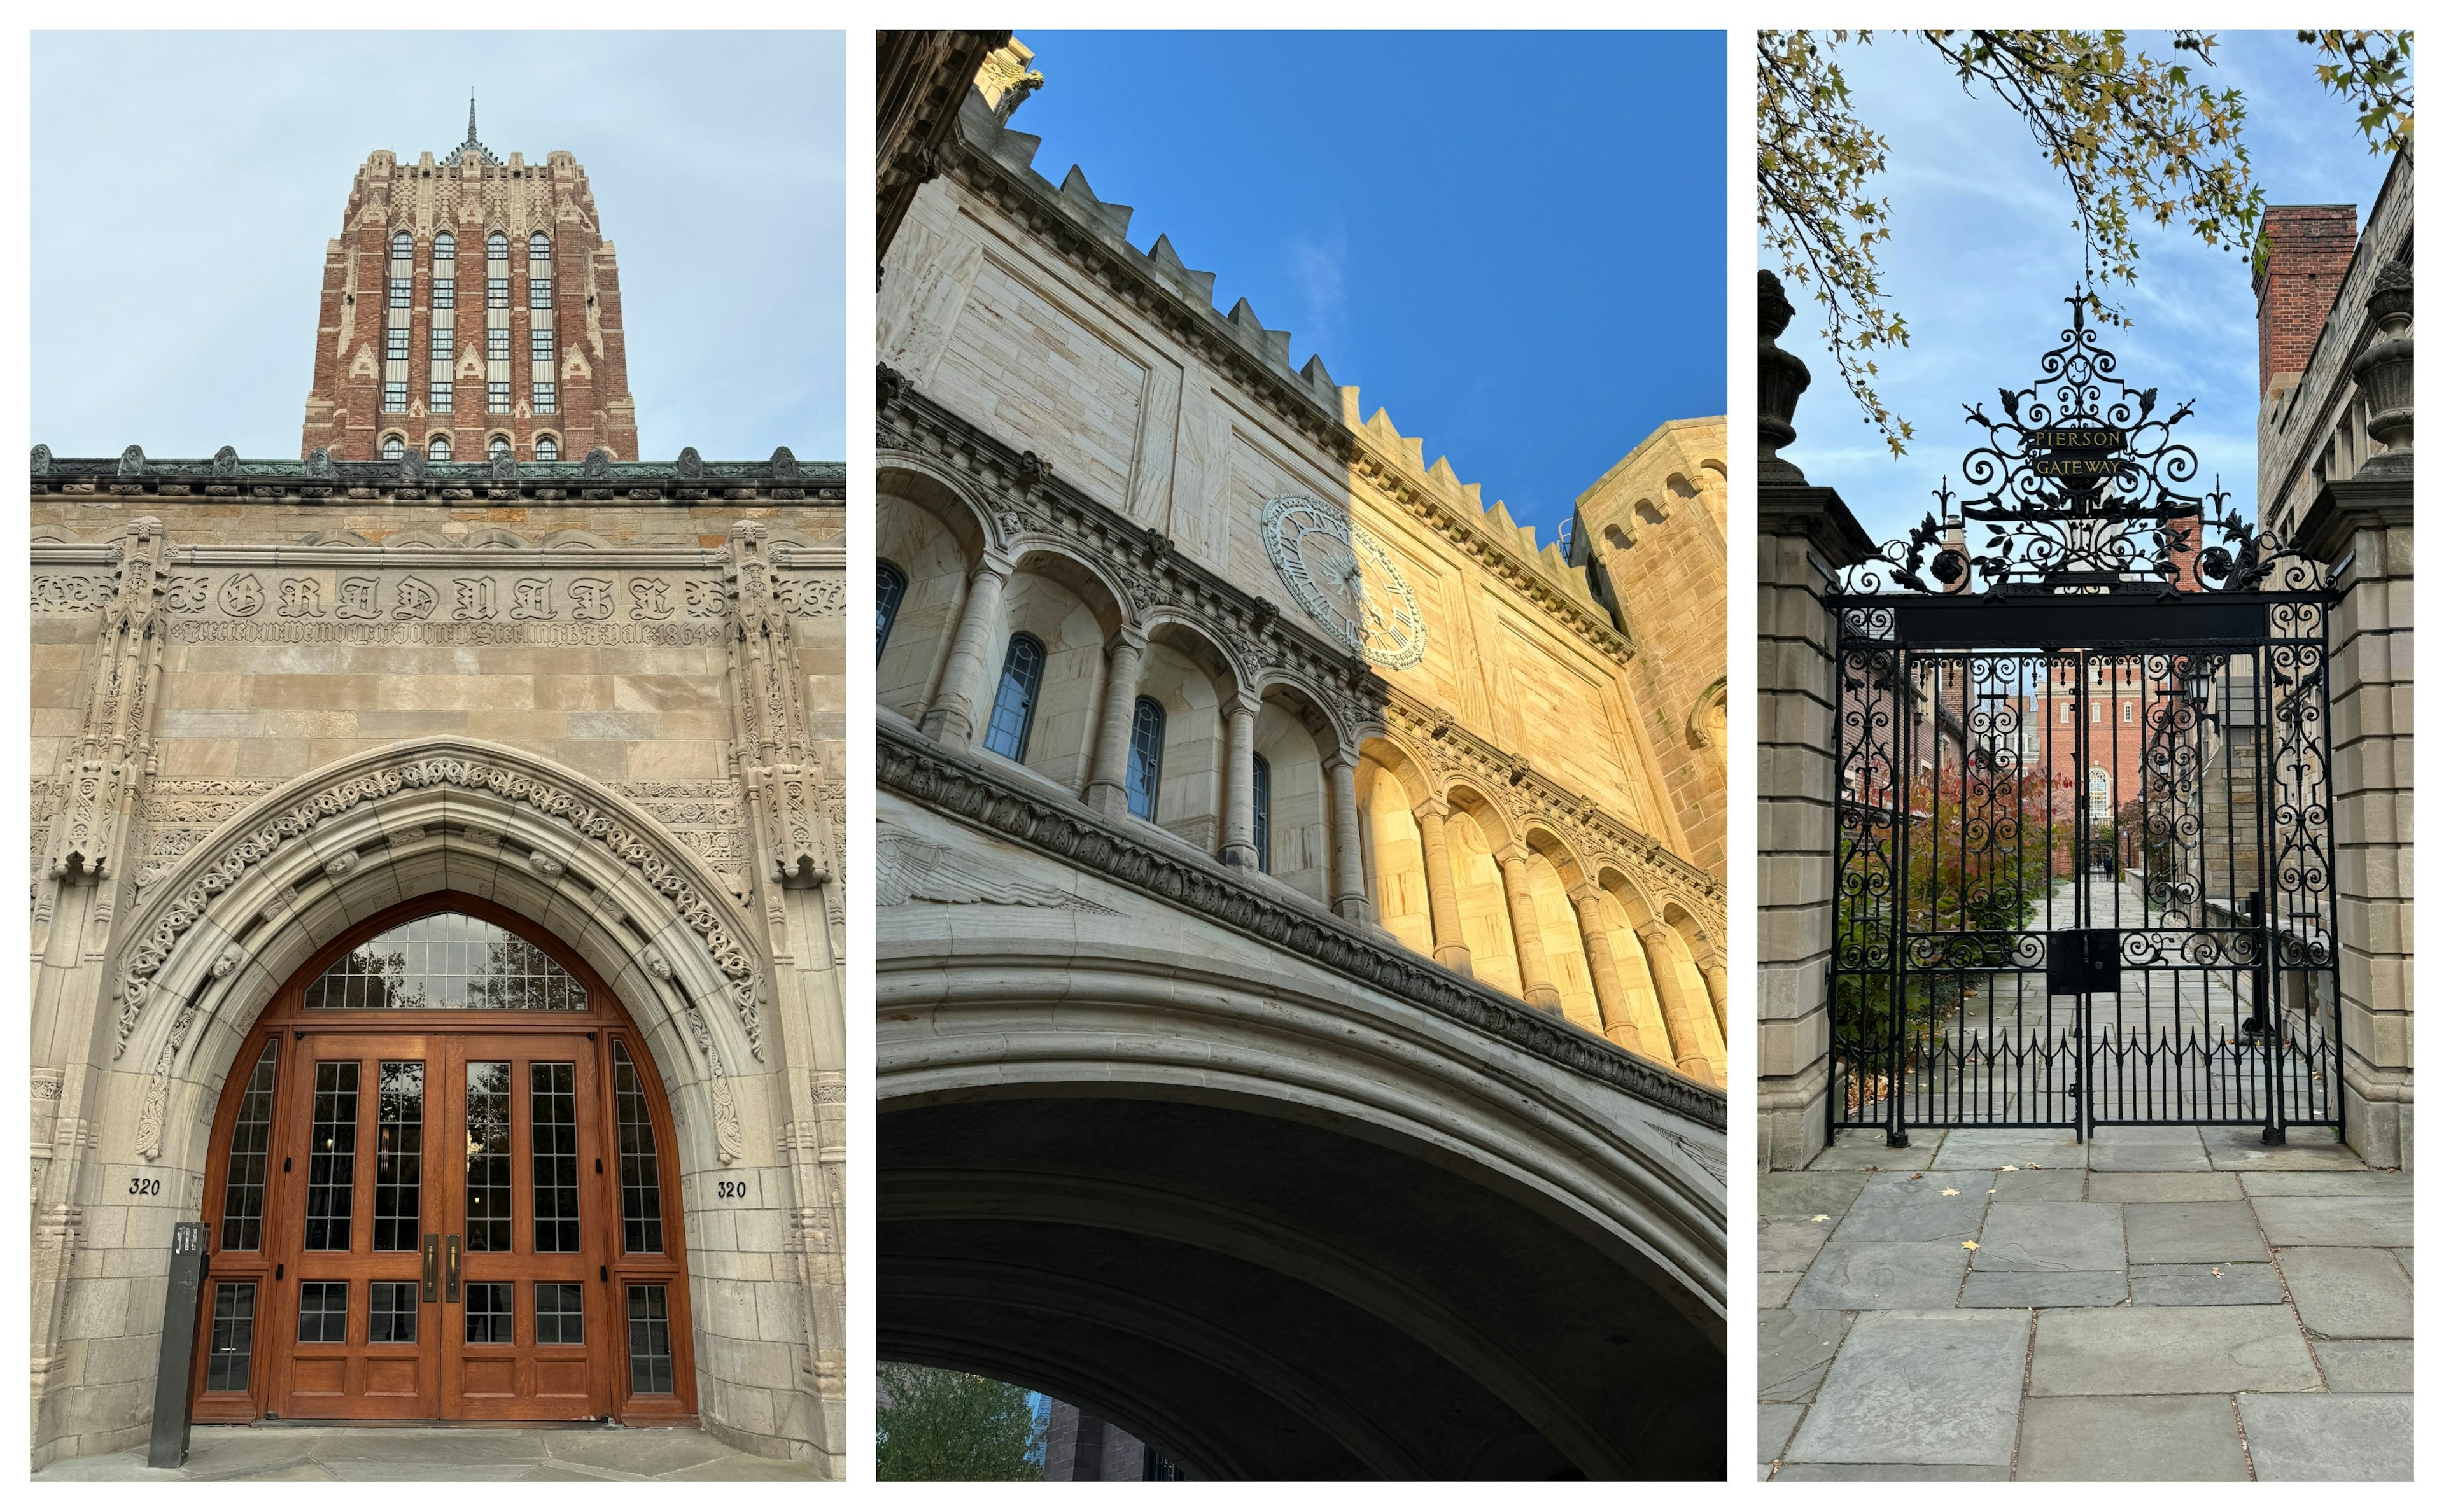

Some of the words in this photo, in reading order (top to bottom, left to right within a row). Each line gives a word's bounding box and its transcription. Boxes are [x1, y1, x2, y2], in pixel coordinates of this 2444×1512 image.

[2036, 431, 2121, 447] PIERSON
[2037, 460, 2123, 475] GATEWAY
[657, 622, 708, 647] 1864
[129, 1178, 160, 1196] 320
[718, 1182, 746, 1198] 320
